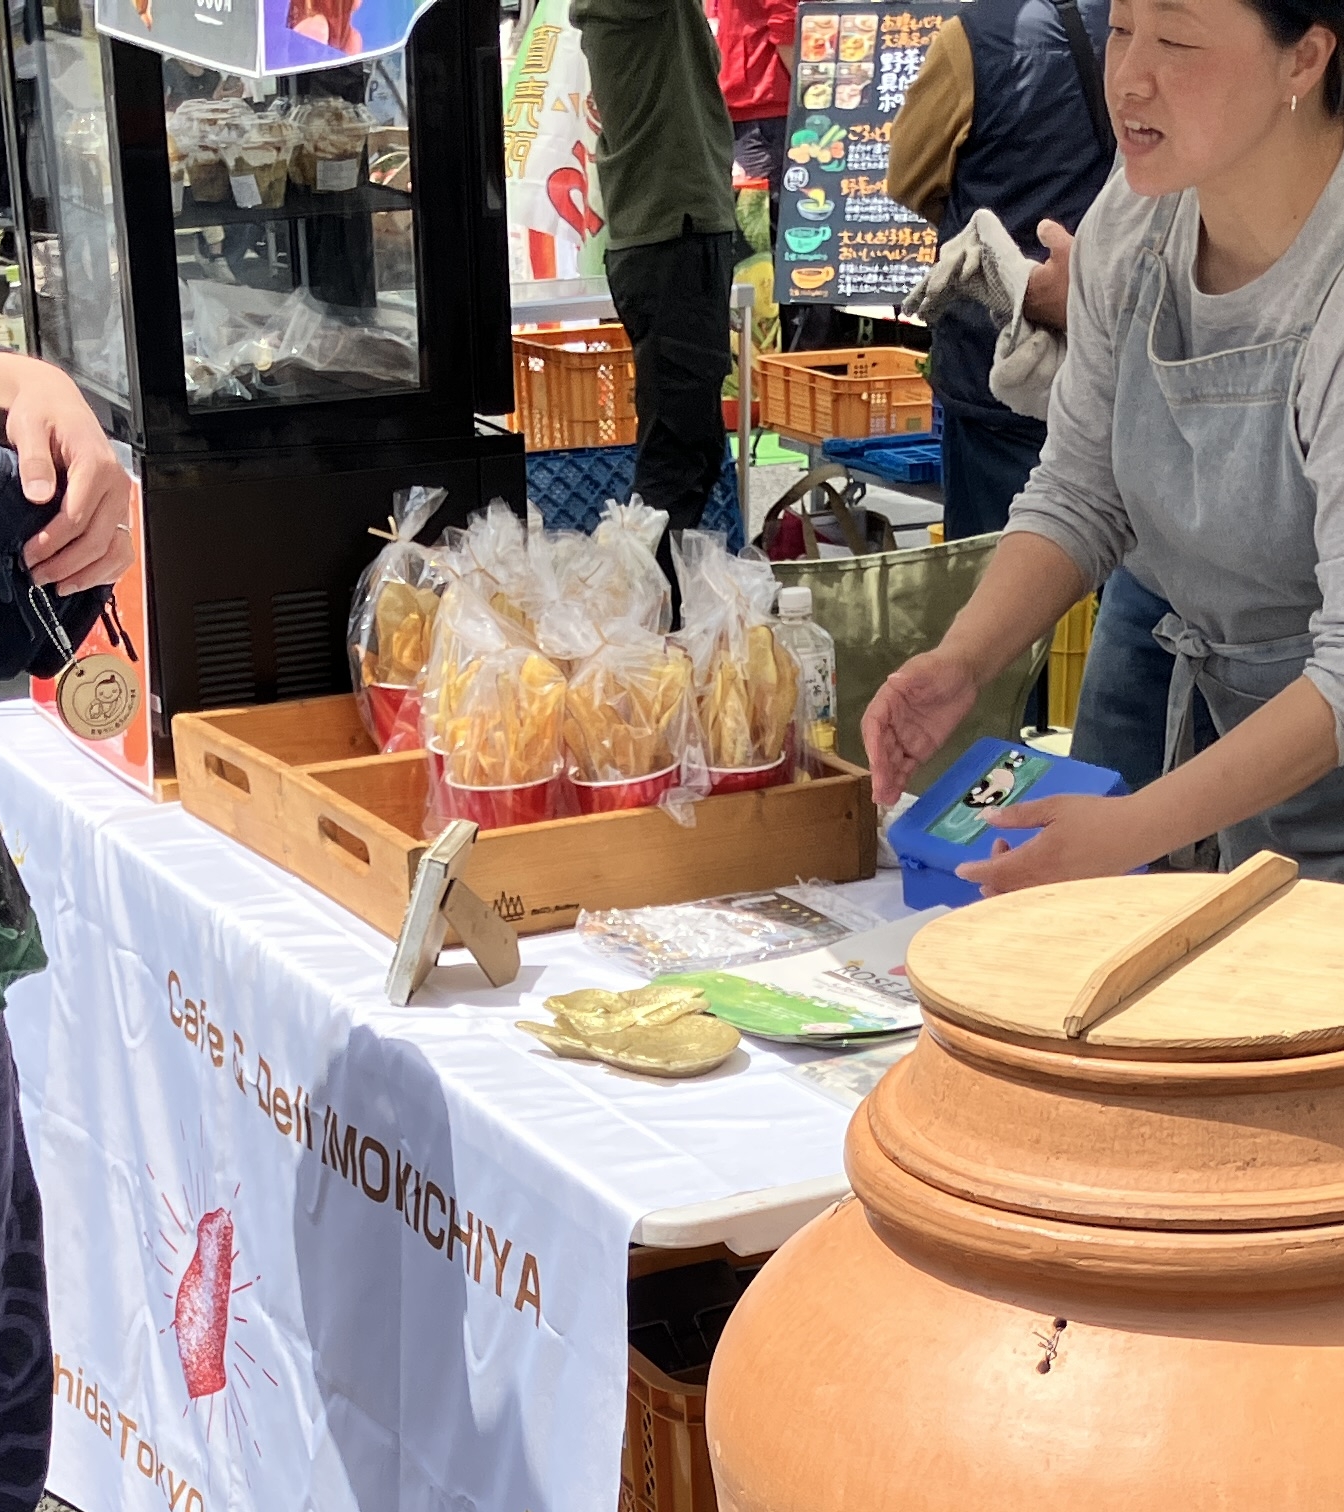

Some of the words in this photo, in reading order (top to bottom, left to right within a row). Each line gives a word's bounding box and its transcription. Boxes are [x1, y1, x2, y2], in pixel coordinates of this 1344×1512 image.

[880, 48, 926, 75] 野菜
[167, 969, 225, 1069] Cafe
[256, 1052, 313, 1151] Deli
[321, 1104, 541, 1329] IMOKICHIYA
[52, 1353, 113, 1441] hida
